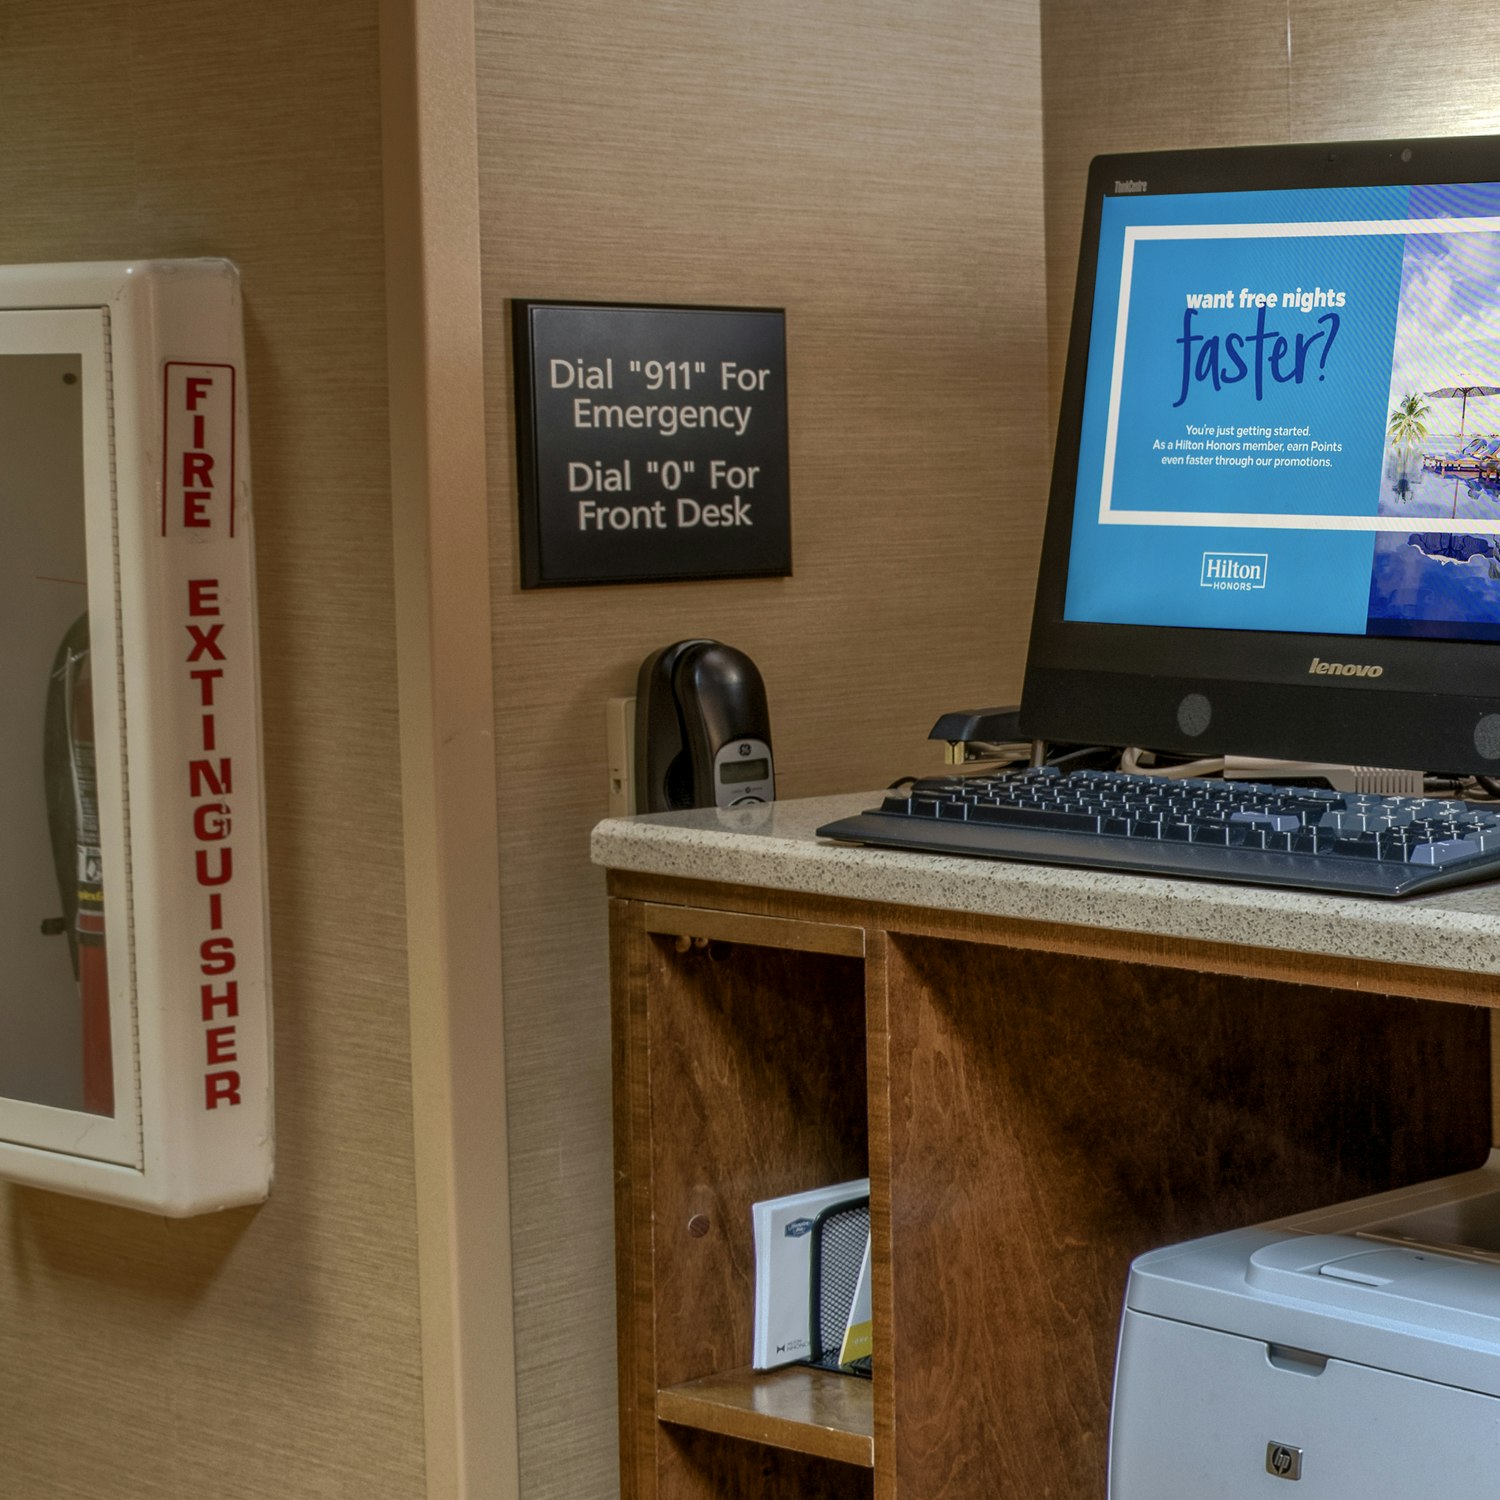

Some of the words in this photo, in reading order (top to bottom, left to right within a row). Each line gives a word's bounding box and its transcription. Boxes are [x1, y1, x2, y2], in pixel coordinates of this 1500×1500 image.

[1186, 290, 1234, 309] want
[1239, 288, 1278, 308] free
[1282, 287, 1346, 313] nights
[1172, 302, 1340, 408] faster?
[550, 358, 613, 389] Dial
[630, 360, 706, 390] "911"
[721, 362, 770, 391] For
[574, 398, 752, 436] Emergency
[1186, 424, 1215, 436] You're
[1216, 425, 1235, 438] just
[1236, 426, 1272, 438] getting
[1273, 426, 1311, 437] started.
[183, 377, 214, 528] FIRE
[1153, 439, 1166, 450] As
[1167, 442, 1173, 450] a
[1175, 440, 1204, 450] Hilton
[1206, 440, 1241, 451] Honors
[1242, 440, 1285, 452] member,
[1286, 443, 1309, 452] earn
[1310, 441, 1342, 452] Points
[568, 460, 631, 492] Dial
[710, 460, 760, 489] For
[1161, 456, 1184, 465] even
[1185, 455, 1214, 465] faster
[1215, 455, 1253, 468] through
[1255, 457, 1272, 466] our
[1273, 457, 1333, 468] promotions.
[578, 500, 667, 531] Front
[677, 495, 753, 528] Desk
[1206, 559, 1261, 579] Hilton
[1213, 581, 1252, 591] HONORS
[1309, 658, 1383, 678] lenovo
[185, 579, 241, 1110] EXTINGUISHER
